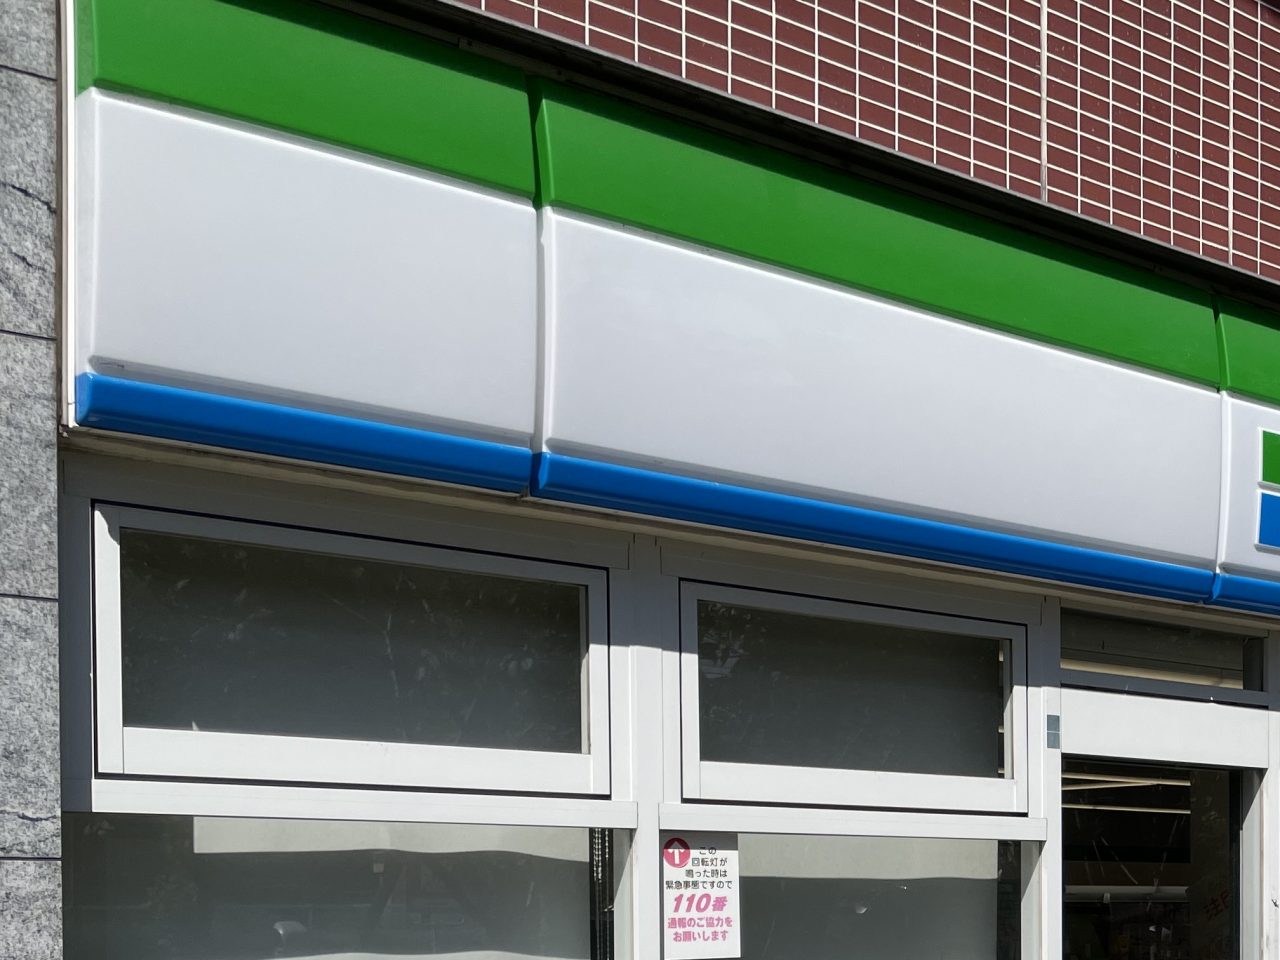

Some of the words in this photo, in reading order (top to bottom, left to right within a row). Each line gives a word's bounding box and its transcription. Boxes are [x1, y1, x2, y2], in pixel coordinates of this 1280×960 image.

[699, 847, 717, 855] この
[692, 858, 728, 867] 回転灯が
[685, 869, 728, 878] 鳴った時は
[665, 881, 733, 889] 緊急事態ですので
[673, 893, 729, 913] 110番
[668, 917, 733, 929] 通報のご協力を
[673, 930, 729, 942] お願いします
